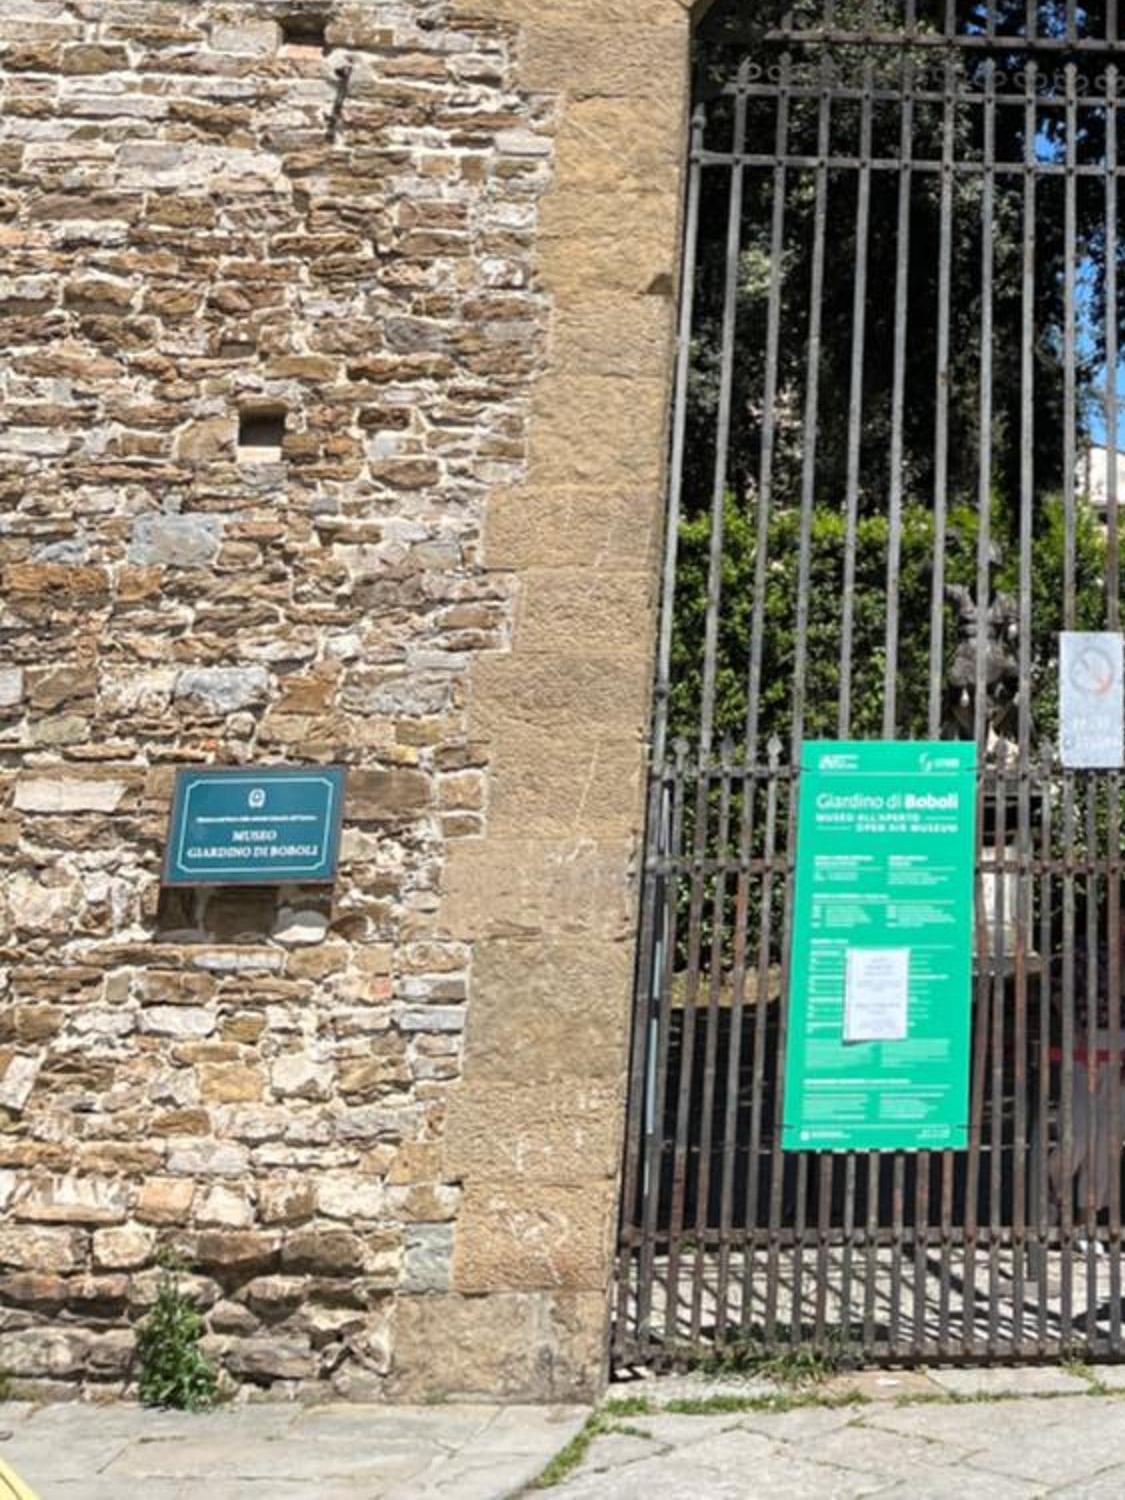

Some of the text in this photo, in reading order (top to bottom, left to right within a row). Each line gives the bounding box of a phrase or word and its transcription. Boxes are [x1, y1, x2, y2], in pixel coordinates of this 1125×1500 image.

[816, 793, 959, 809] Giardino di Boboli
[816, 813, 854, 822] MUSEO
[856, 823, 885, 832] OPEN
[911, 823, 959, 832] MUSEUM
[231, 830, 277, 841] MUSEO
[187, 845, 318, 858] GIARDINO DI BOBOLI
